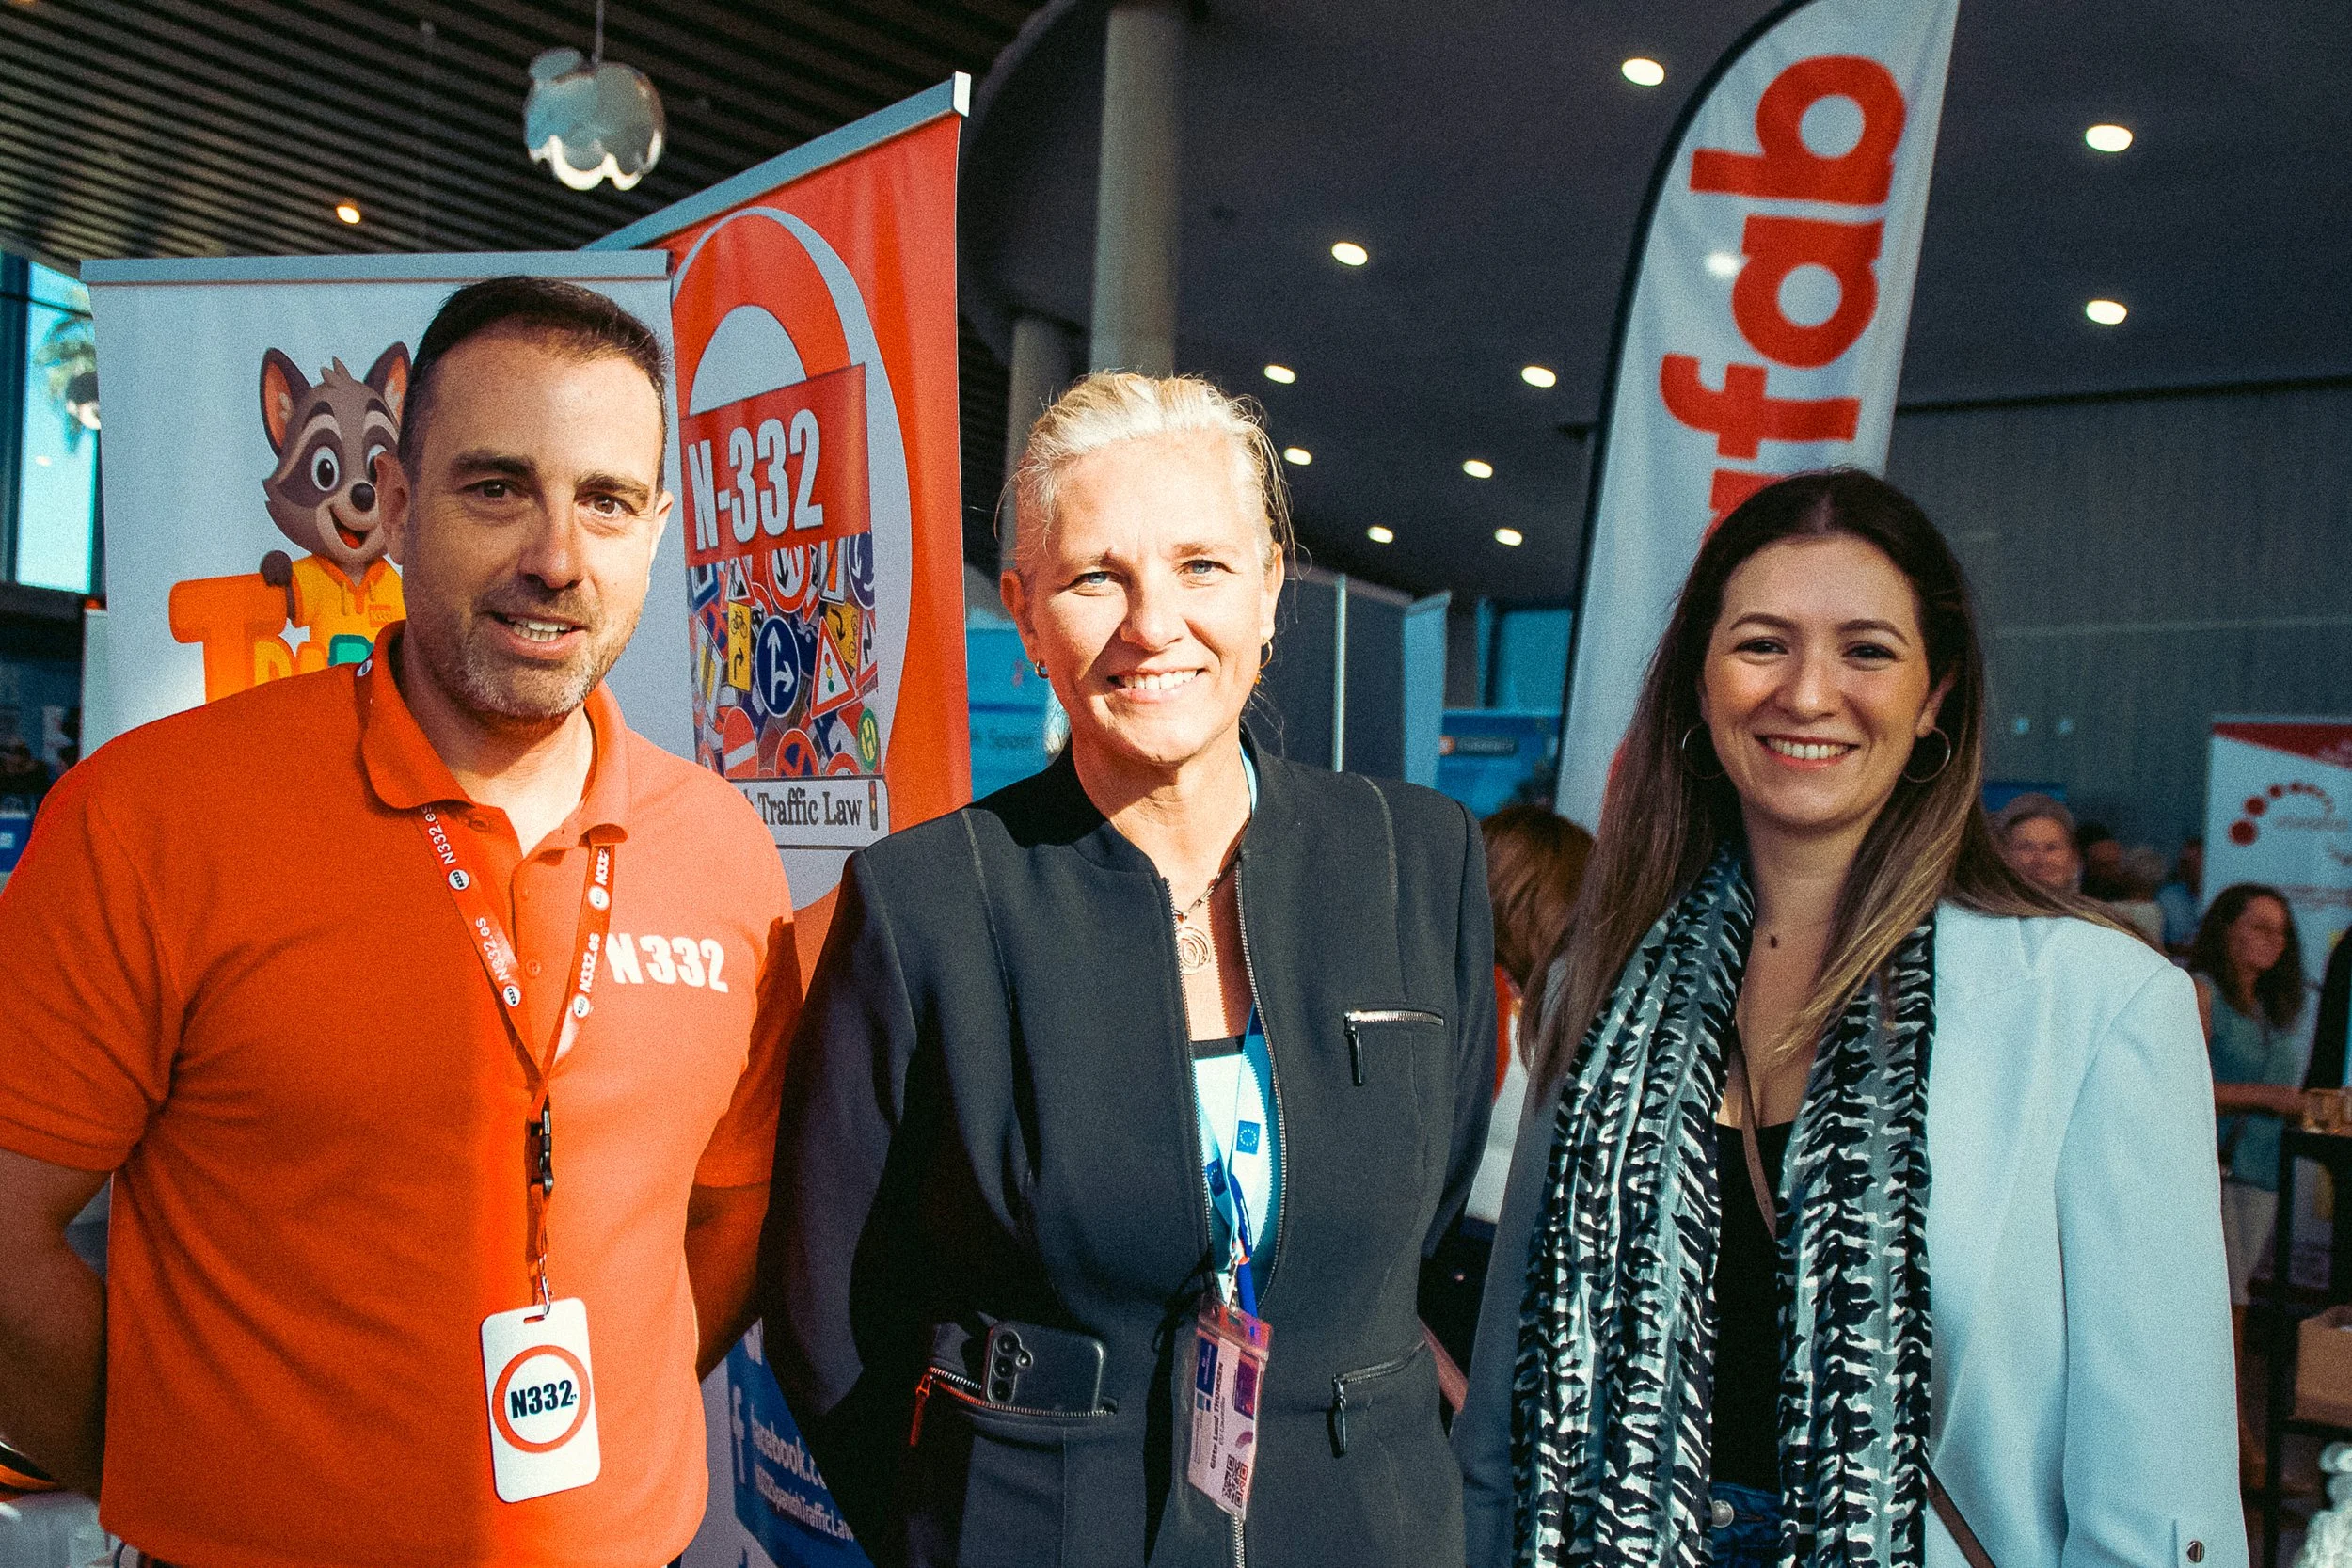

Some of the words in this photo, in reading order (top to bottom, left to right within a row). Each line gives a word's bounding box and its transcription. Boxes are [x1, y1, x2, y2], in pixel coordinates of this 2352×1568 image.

[1660, 54, 1907, 546] fab
[687, 407, 824, 552] N-332
[757, 786, 818, 826] Traffic
[822, 791, 863, 826] Law
[475, 917, 511, 981] N332.es
[605, 932, 729, 993] N332
